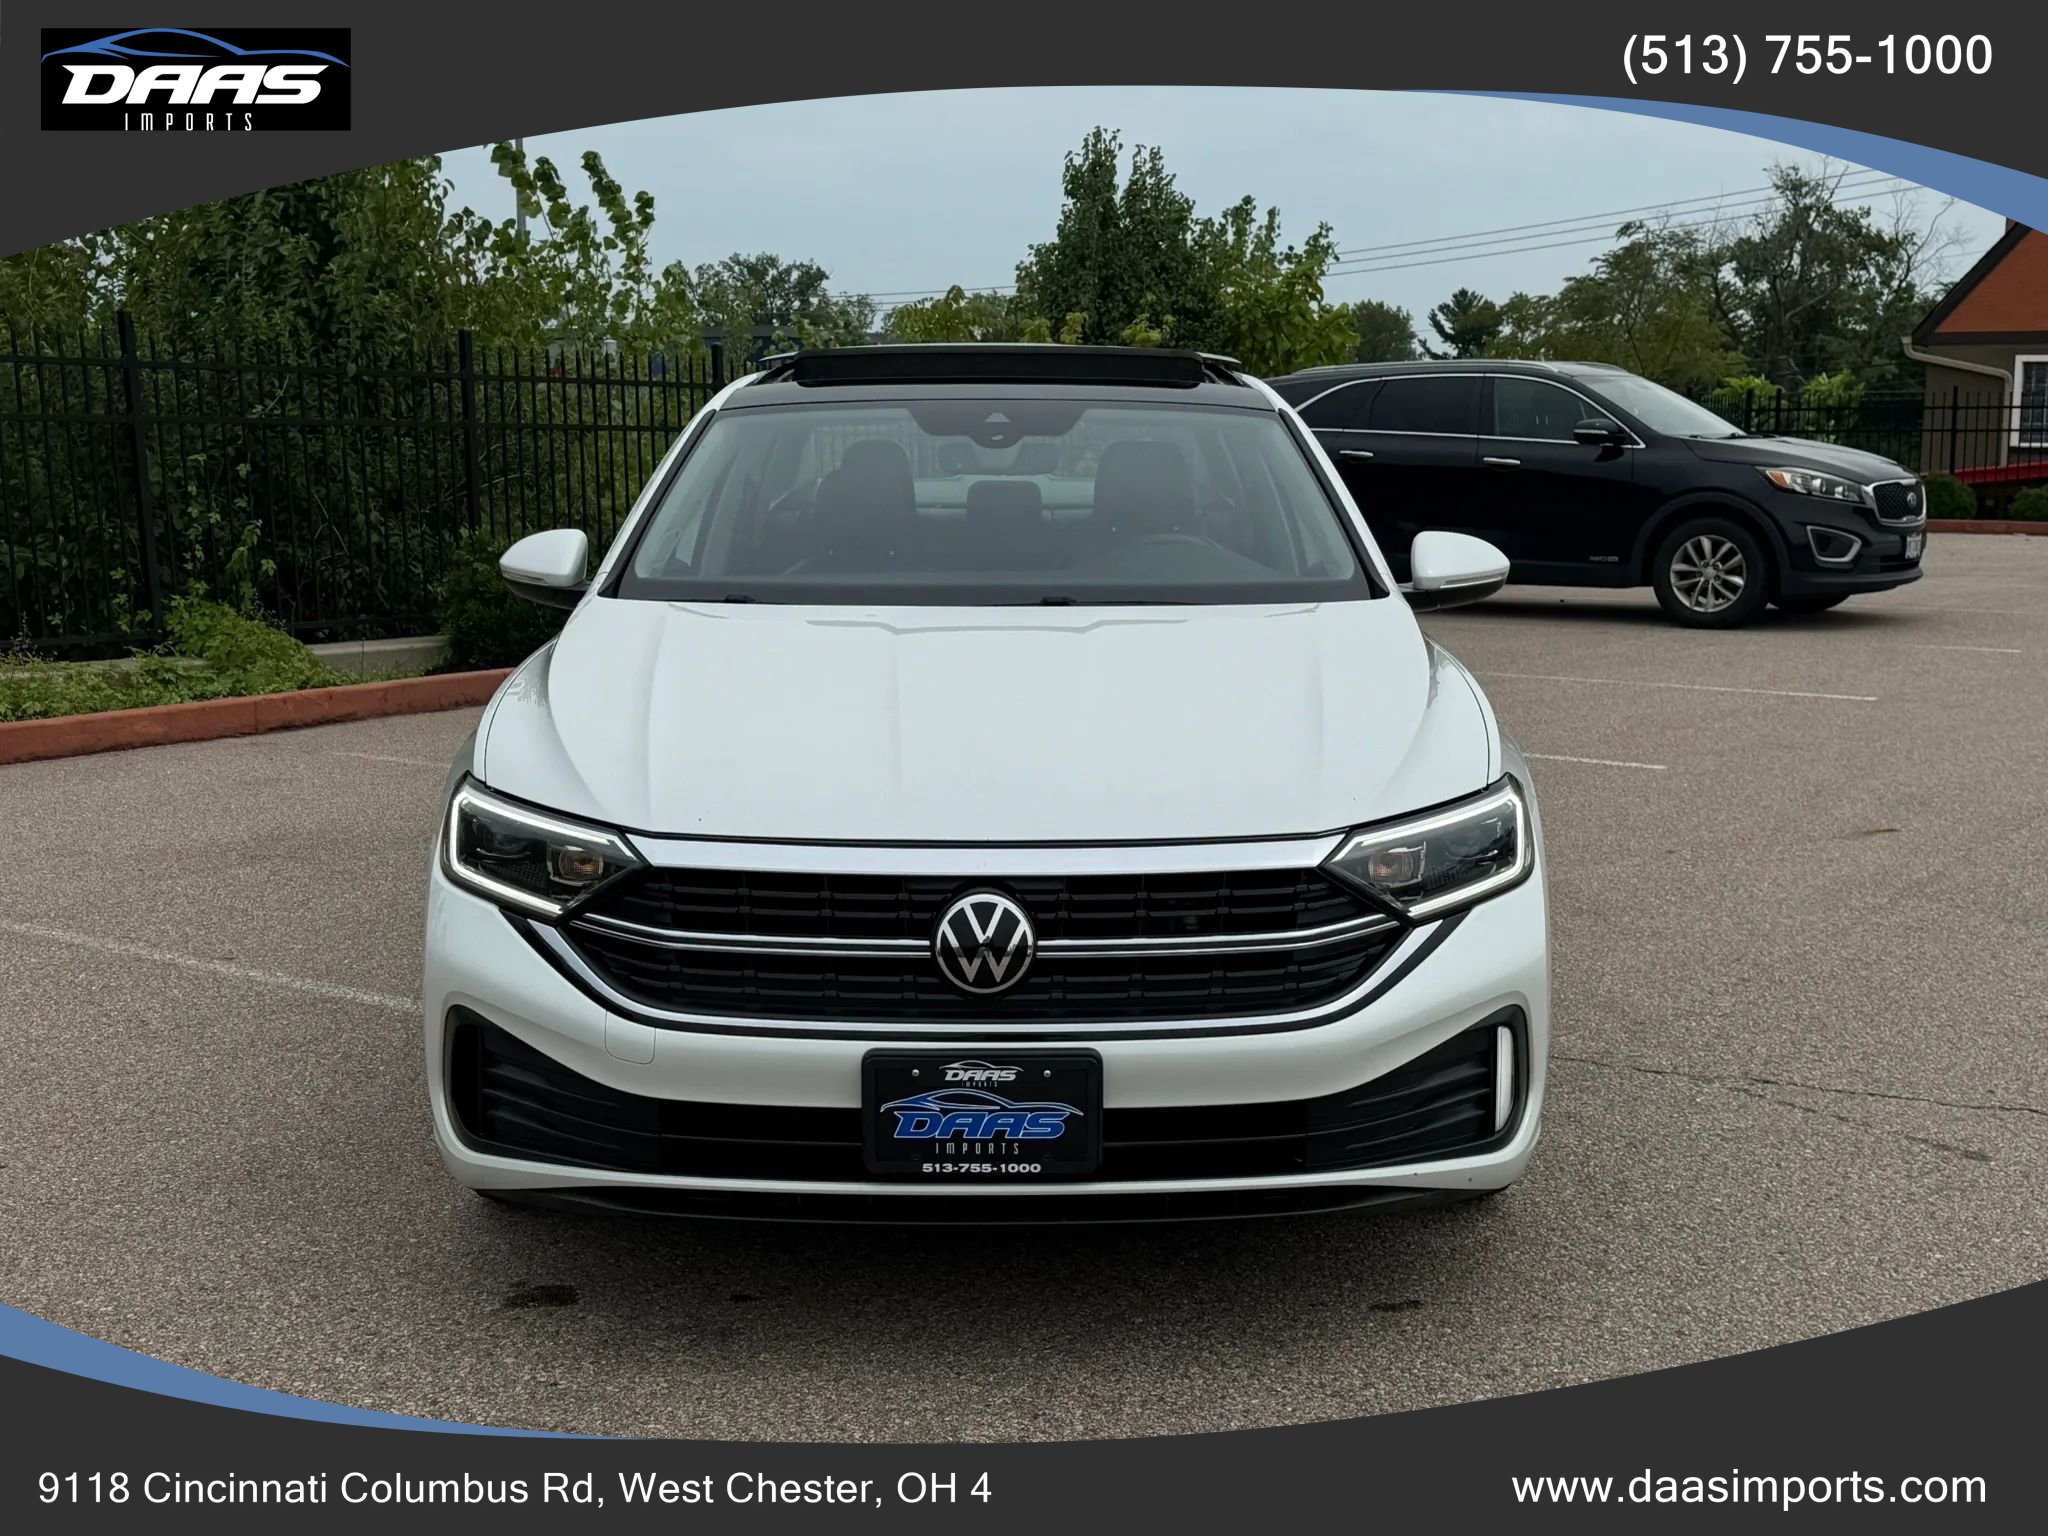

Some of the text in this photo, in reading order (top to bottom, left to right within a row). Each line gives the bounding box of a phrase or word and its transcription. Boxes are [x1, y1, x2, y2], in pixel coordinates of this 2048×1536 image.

[944, 1069, 1018, 1082] DAAS
[893, 1110, 1071, 1139] DAAS
[935, 1142, 1020, 1156] IMPORTS
[921, 1162, 1043, 1174] 513-755-1000
